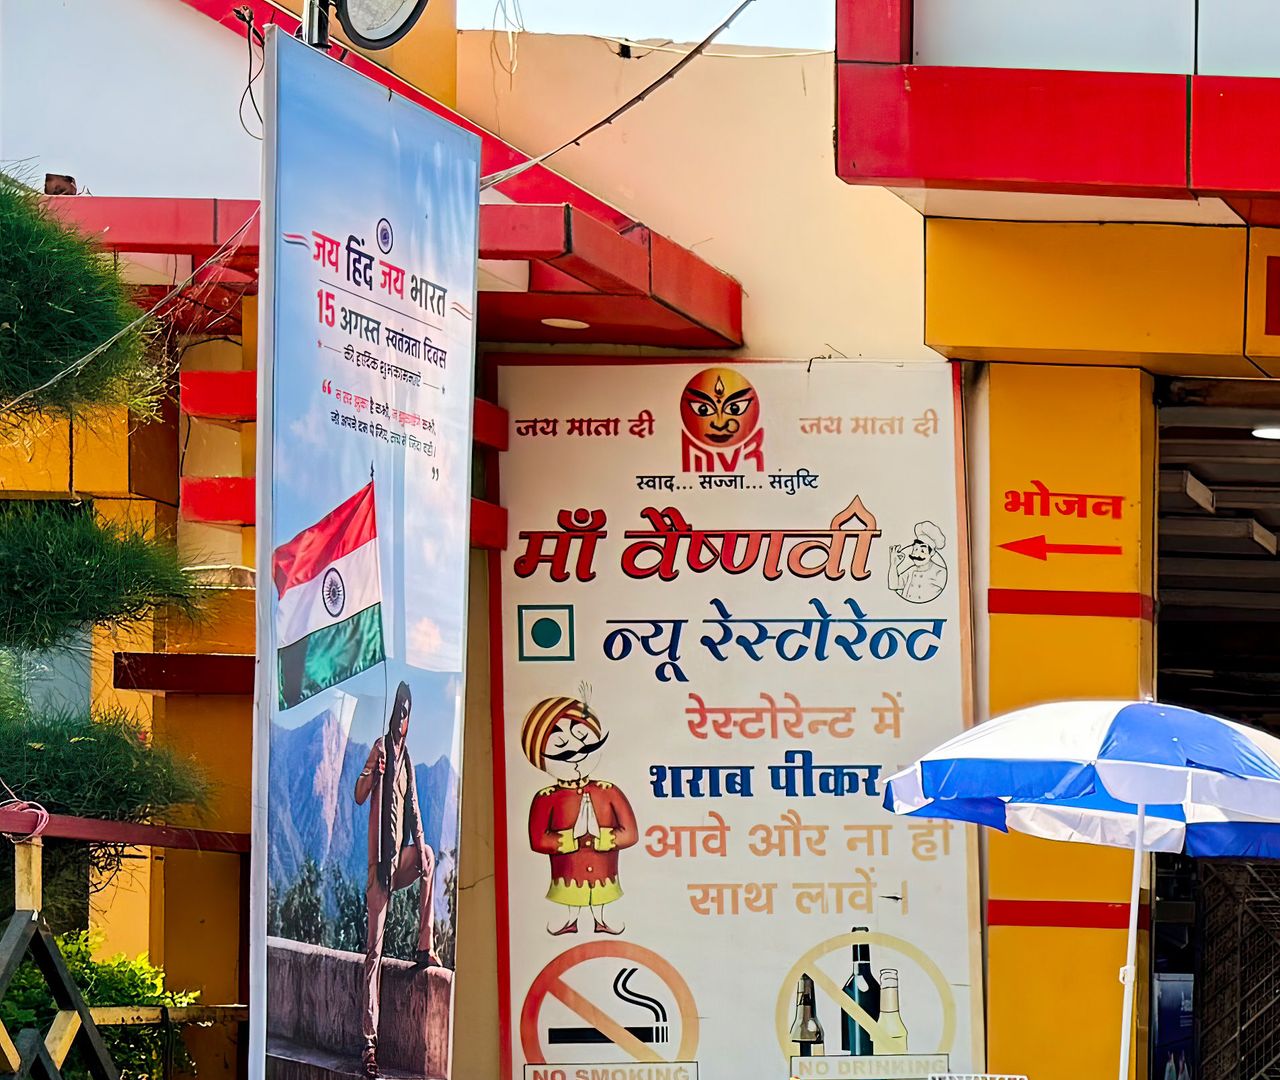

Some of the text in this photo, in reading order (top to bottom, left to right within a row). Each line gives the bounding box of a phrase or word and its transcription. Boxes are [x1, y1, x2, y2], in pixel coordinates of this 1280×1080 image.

[312, 231, 447, 317] जय हिंद जय भारत
[317, 289, 447, 369] 15 अगस्त स्वतंत्रता दिवस
[515, 409, 656, 439] जय माता दी
[800, 408, 940, 437] जय माता दी
[768, 468, 819, 495] संतुष्टि
[1004, 479, 1127, 519] भोजन
[513, 494, 882, 583] माँ वैष्णवी
[603, 597, 948, 682] न्यू रेस्टोरेन्ट
[686, 692, 904, 740] रेस्टोरेन्ट में
[649, 749, 882, 798] शराब पीकर
[644, 811, 731, 859] आवे
[748, 808, 830, 858] और
[843, 824, 893, 858] ना
[687, 881, 777, 916] साथ
[791, 866, 878, 916] लावें
[799, 1059, 946, 1075] NO DRINKING
